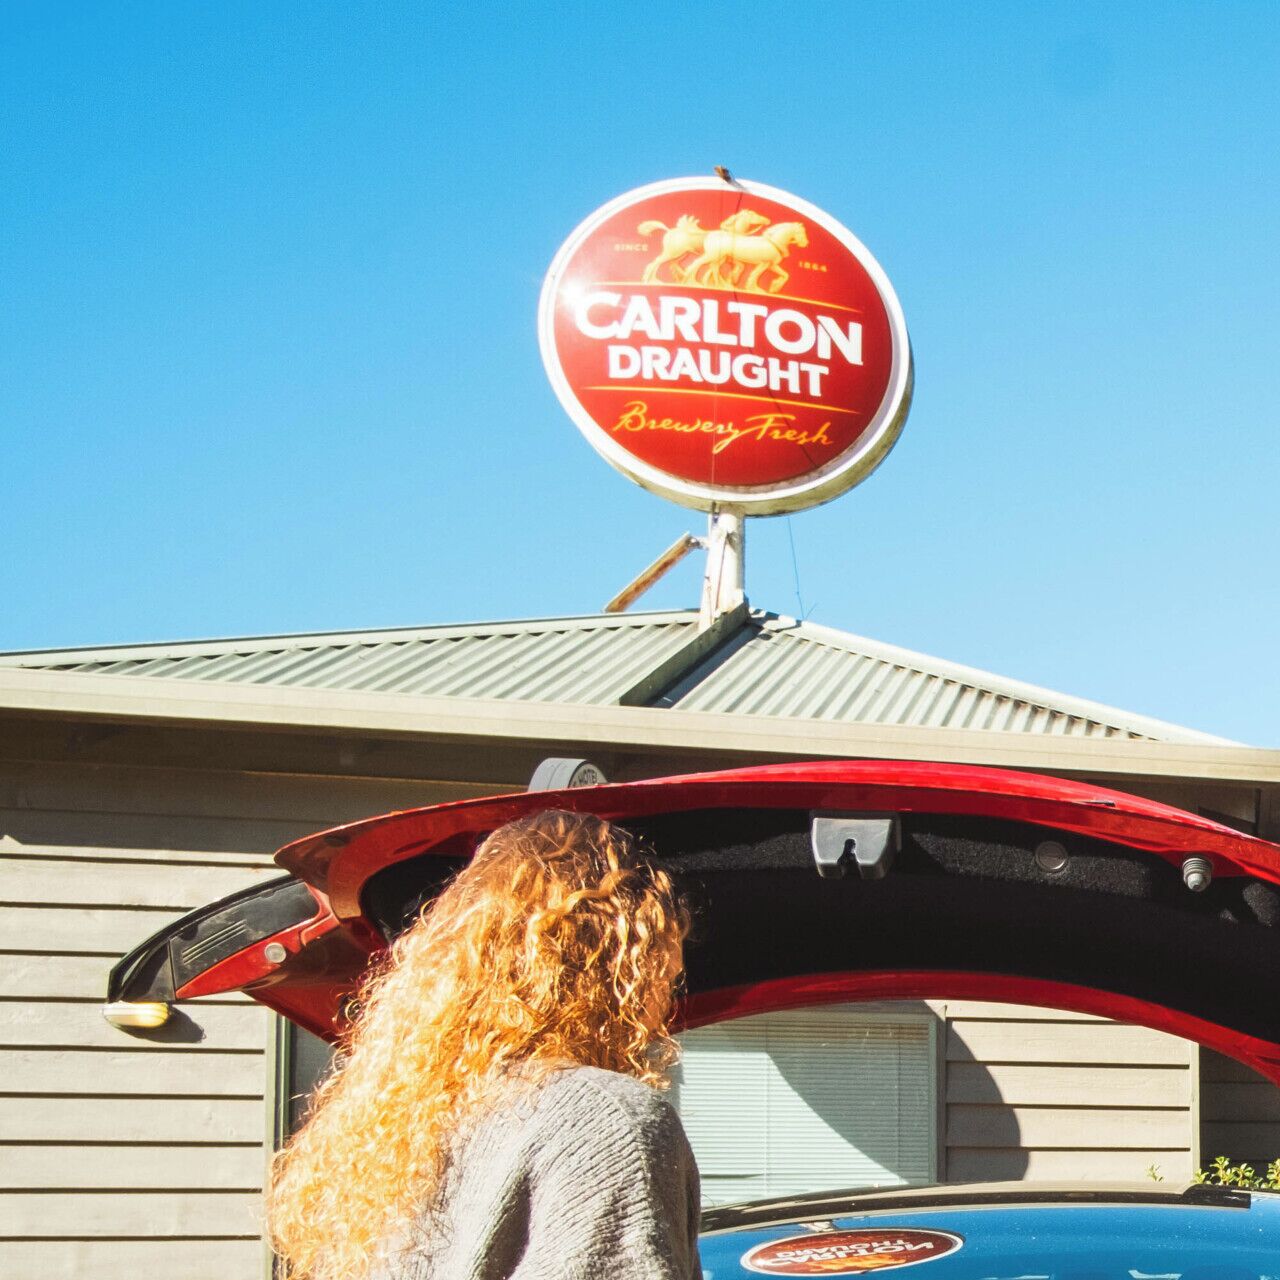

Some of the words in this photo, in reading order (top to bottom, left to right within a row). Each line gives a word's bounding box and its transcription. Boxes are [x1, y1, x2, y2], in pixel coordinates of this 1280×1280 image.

[573, 291, 864, 366] CARLTON
[608, 345, 830, 397] DRAUGHT
[613, 400, 744, 454] Brewery
[744, 413, 834, 445] Fresh
